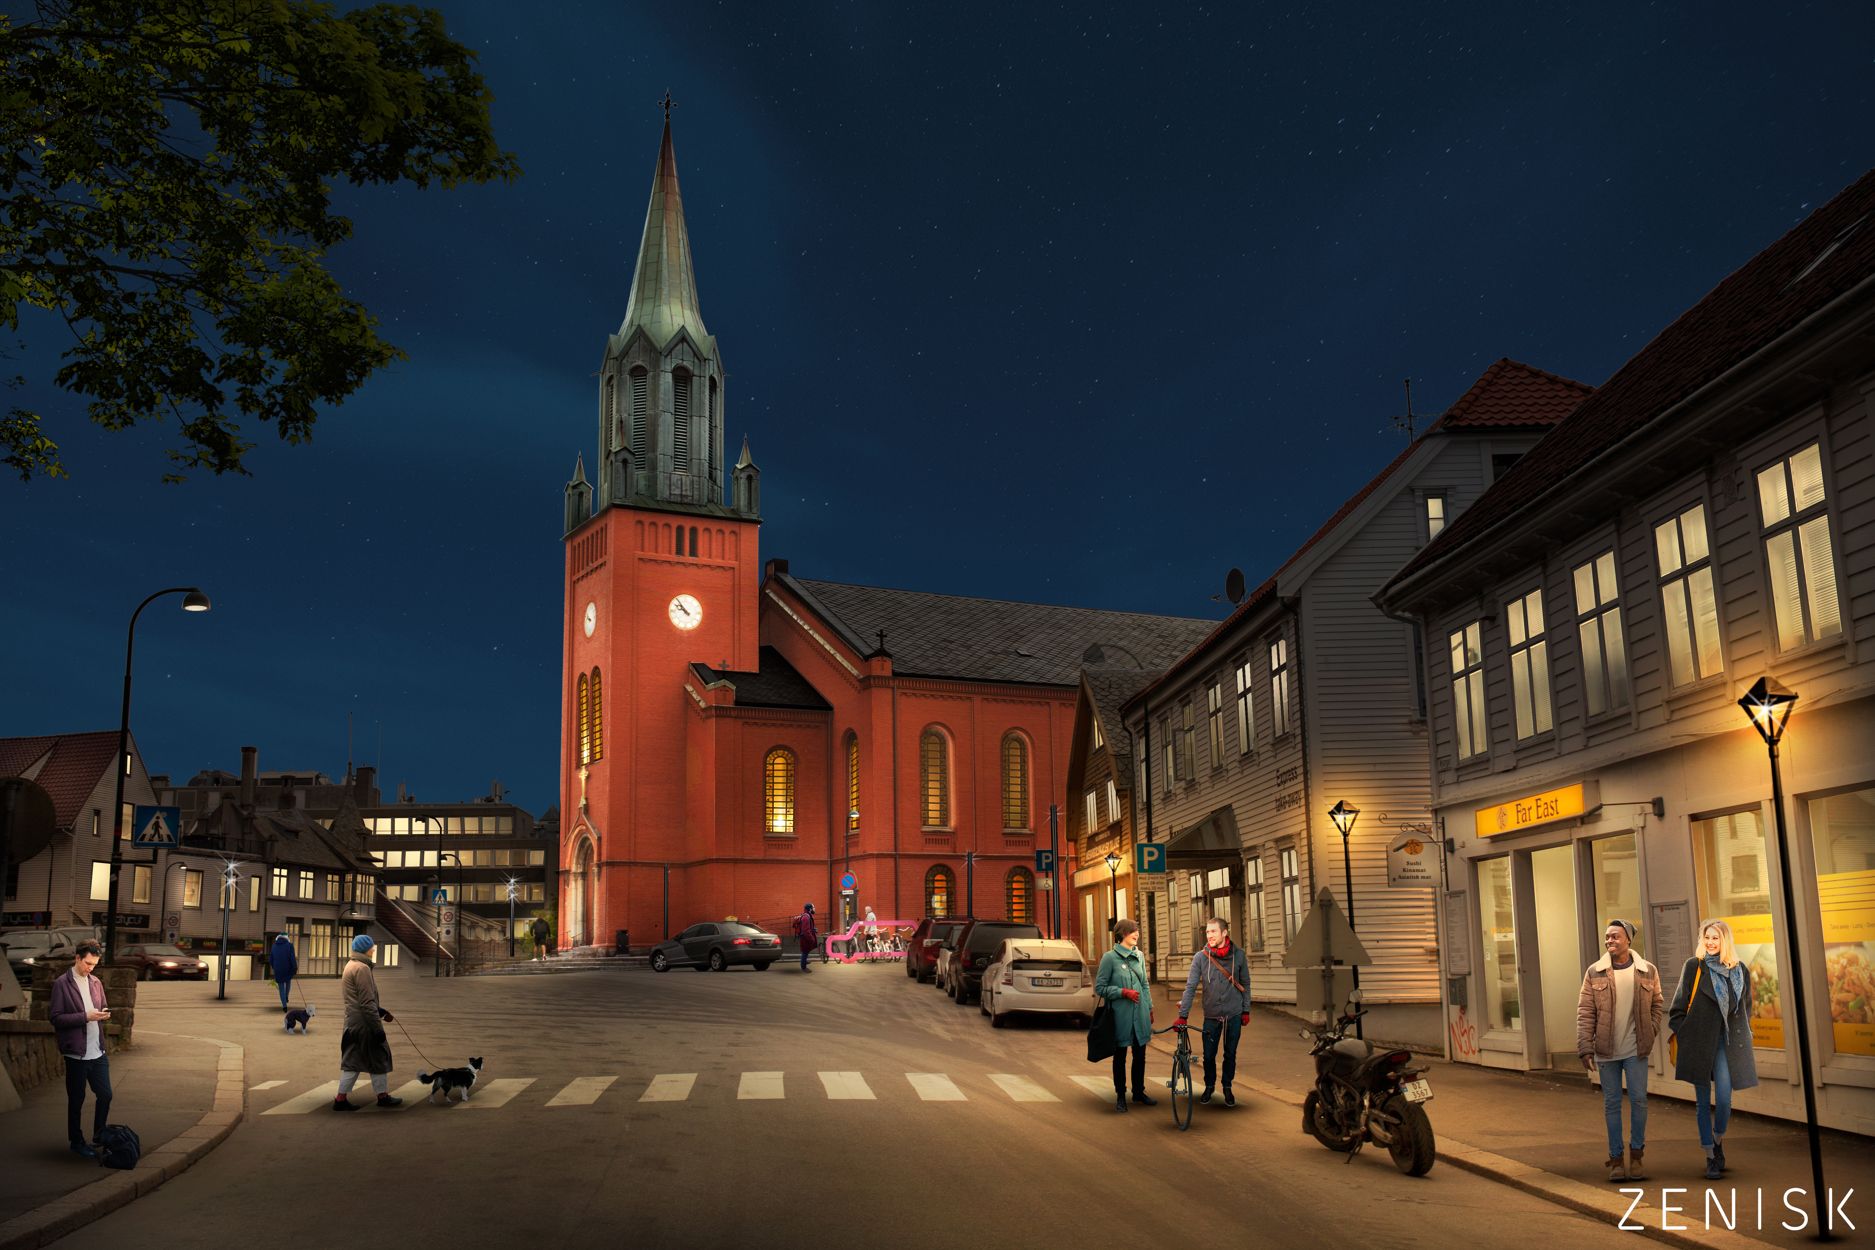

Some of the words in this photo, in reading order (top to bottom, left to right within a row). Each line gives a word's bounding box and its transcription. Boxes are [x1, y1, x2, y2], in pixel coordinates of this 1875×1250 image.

[1276, 766, 1298, 789] Express
[1515, 803, 1532, 824] Far
[1535, 796, 1559, 820] East
[1041, 852, 1052, 869] P
[1143, 847, 1159, 869] P
[1411, 1082, 1422, 1090] DZ
[1411, 1088, 1428, 1099] 3567
